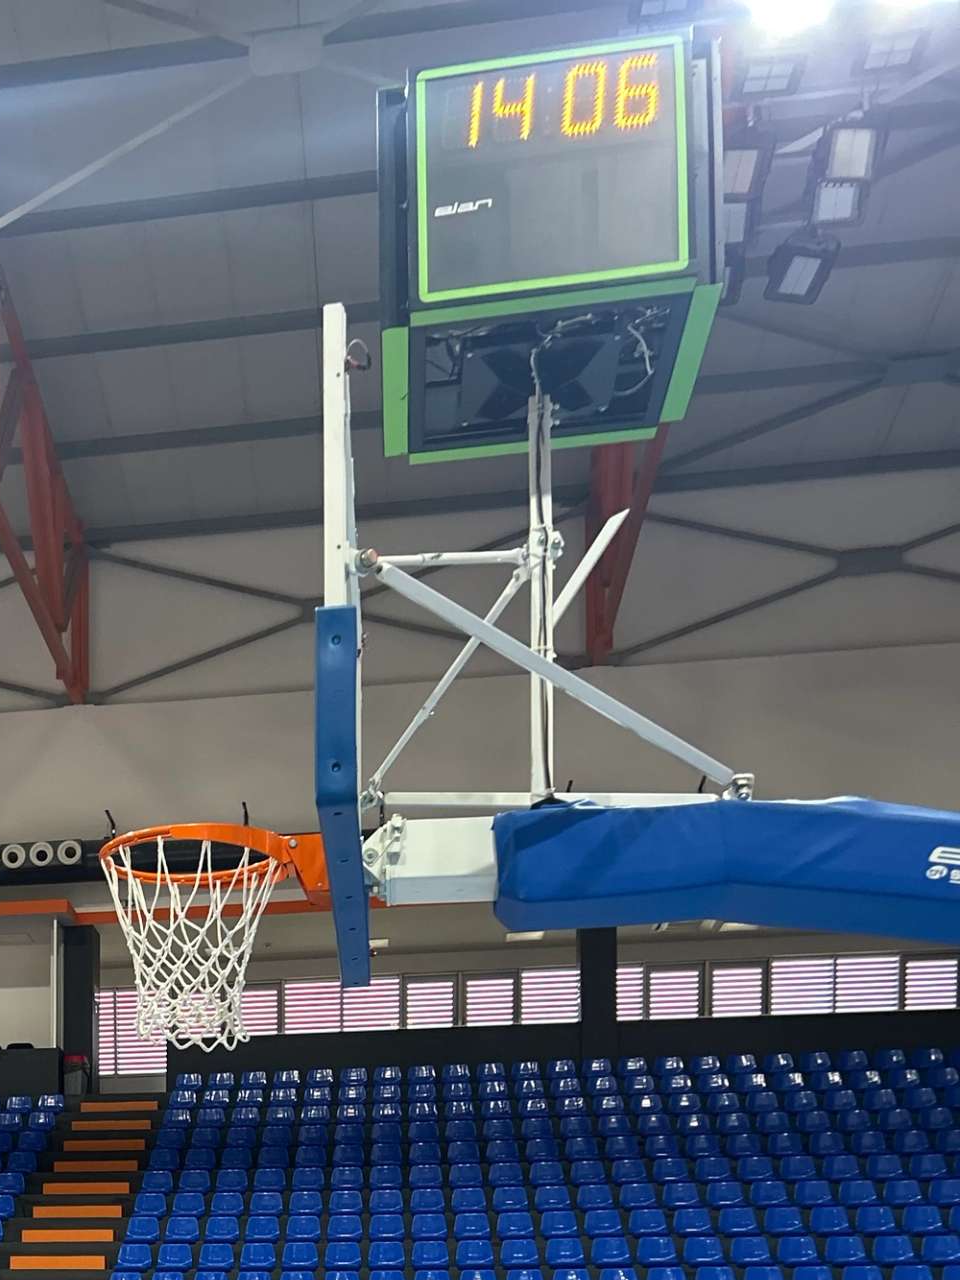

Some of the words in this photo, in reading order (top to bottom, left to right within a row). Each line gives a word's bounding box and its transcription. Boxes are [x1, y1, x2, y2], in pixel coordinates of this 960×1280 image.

[467, 72, 535, 148] 14
[561, 52, 658, 137] 06
[434, 198, 493, 217] elan
